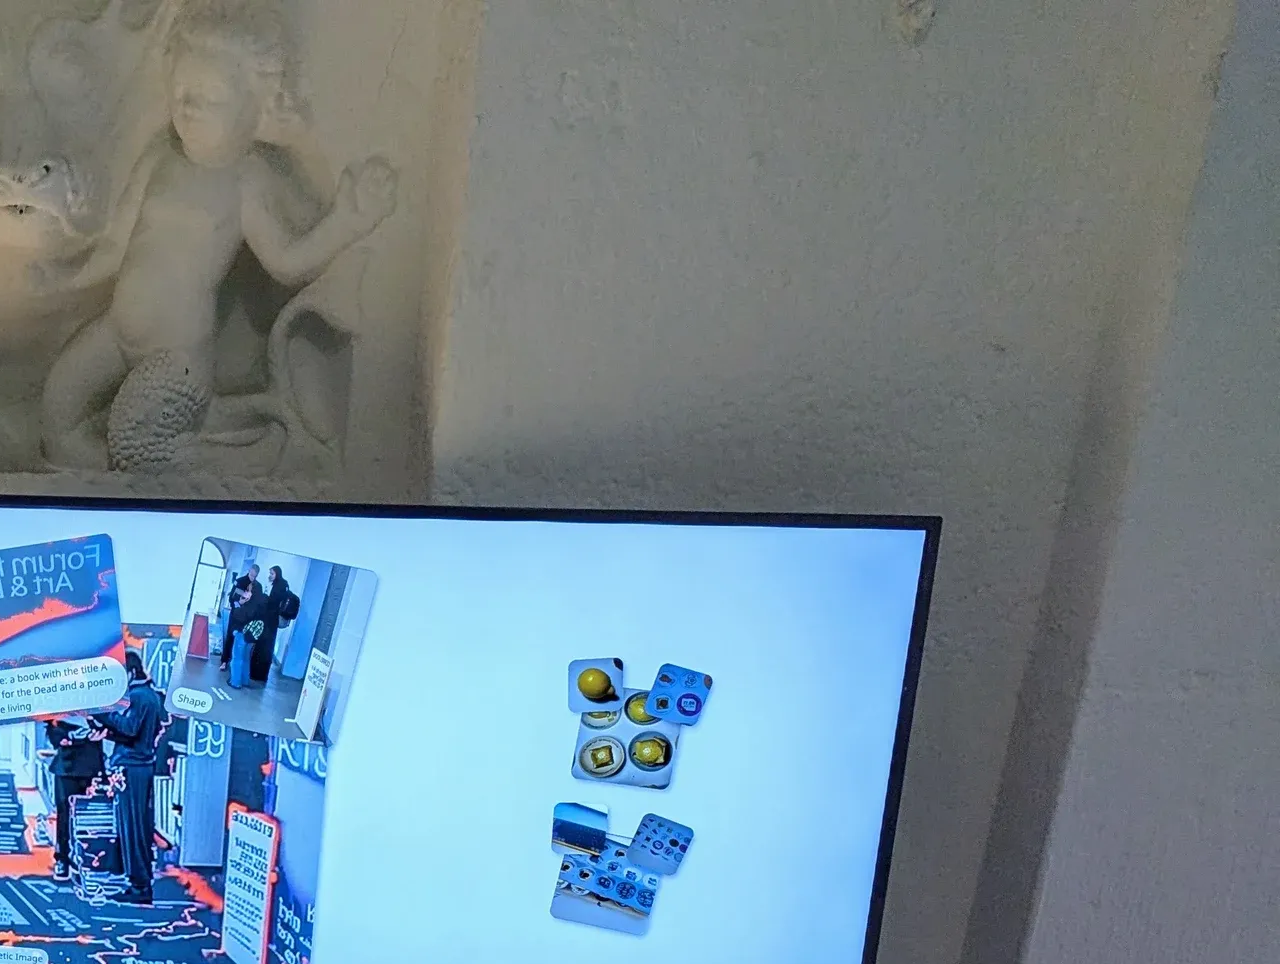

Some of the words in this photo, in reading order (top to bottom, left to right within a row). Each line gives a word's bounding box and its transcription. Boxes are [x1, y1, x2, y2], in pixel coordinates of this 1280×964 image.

[10, 676, 16, 684] a
[17, 670, 40, 682] book
[42, 666, 62, 679] with
[64, 664, 79, 676] the
[80, 663, 99, 674] title
[101, 663, 108, 671] A
[1, 688, 14, 699] for
[17, 686, 32, 697] the
[34, 682, 57, 695] Dead
[60, 679, 77, 691] and
[79, 681, 85, 689] a
[87, 677, 114, 692] poem
[178, 694, 207, 708] Shape
[7, 702, 32, 716] living
[15, 953, 43, 964] Image
